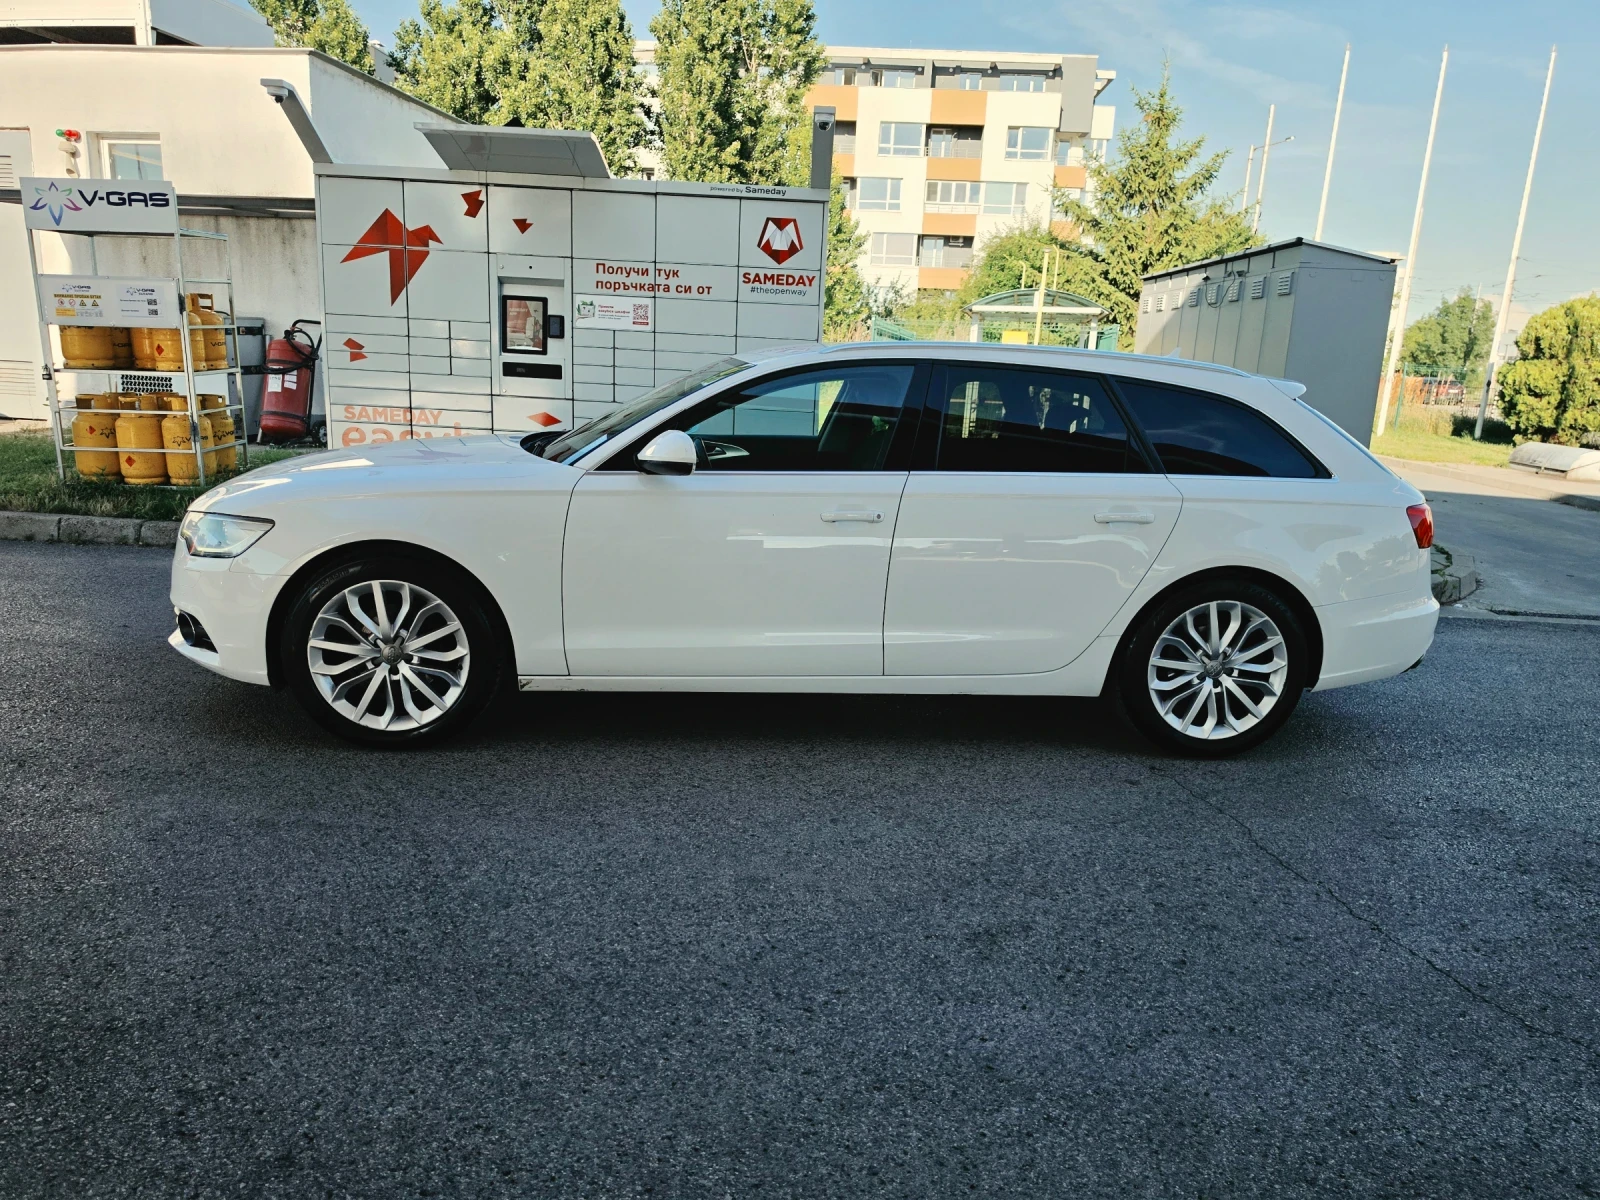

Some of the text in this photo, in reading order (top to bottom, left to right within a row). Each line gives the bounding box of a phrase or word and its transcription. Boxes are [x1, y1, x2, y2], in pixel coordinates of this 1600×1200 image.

[77, 189, 170, 207] V-GAS
[745, 186, 787, 196] Sameday
[595, 263, 680, 280] Получи тук
[742, 272, 816, 287] SAMEDAY
[595, 280, 713, 295] поръчката си от
[750, 286, 807, 296] #theopenway
[344, 405, 443, 425] SAMEDAY
